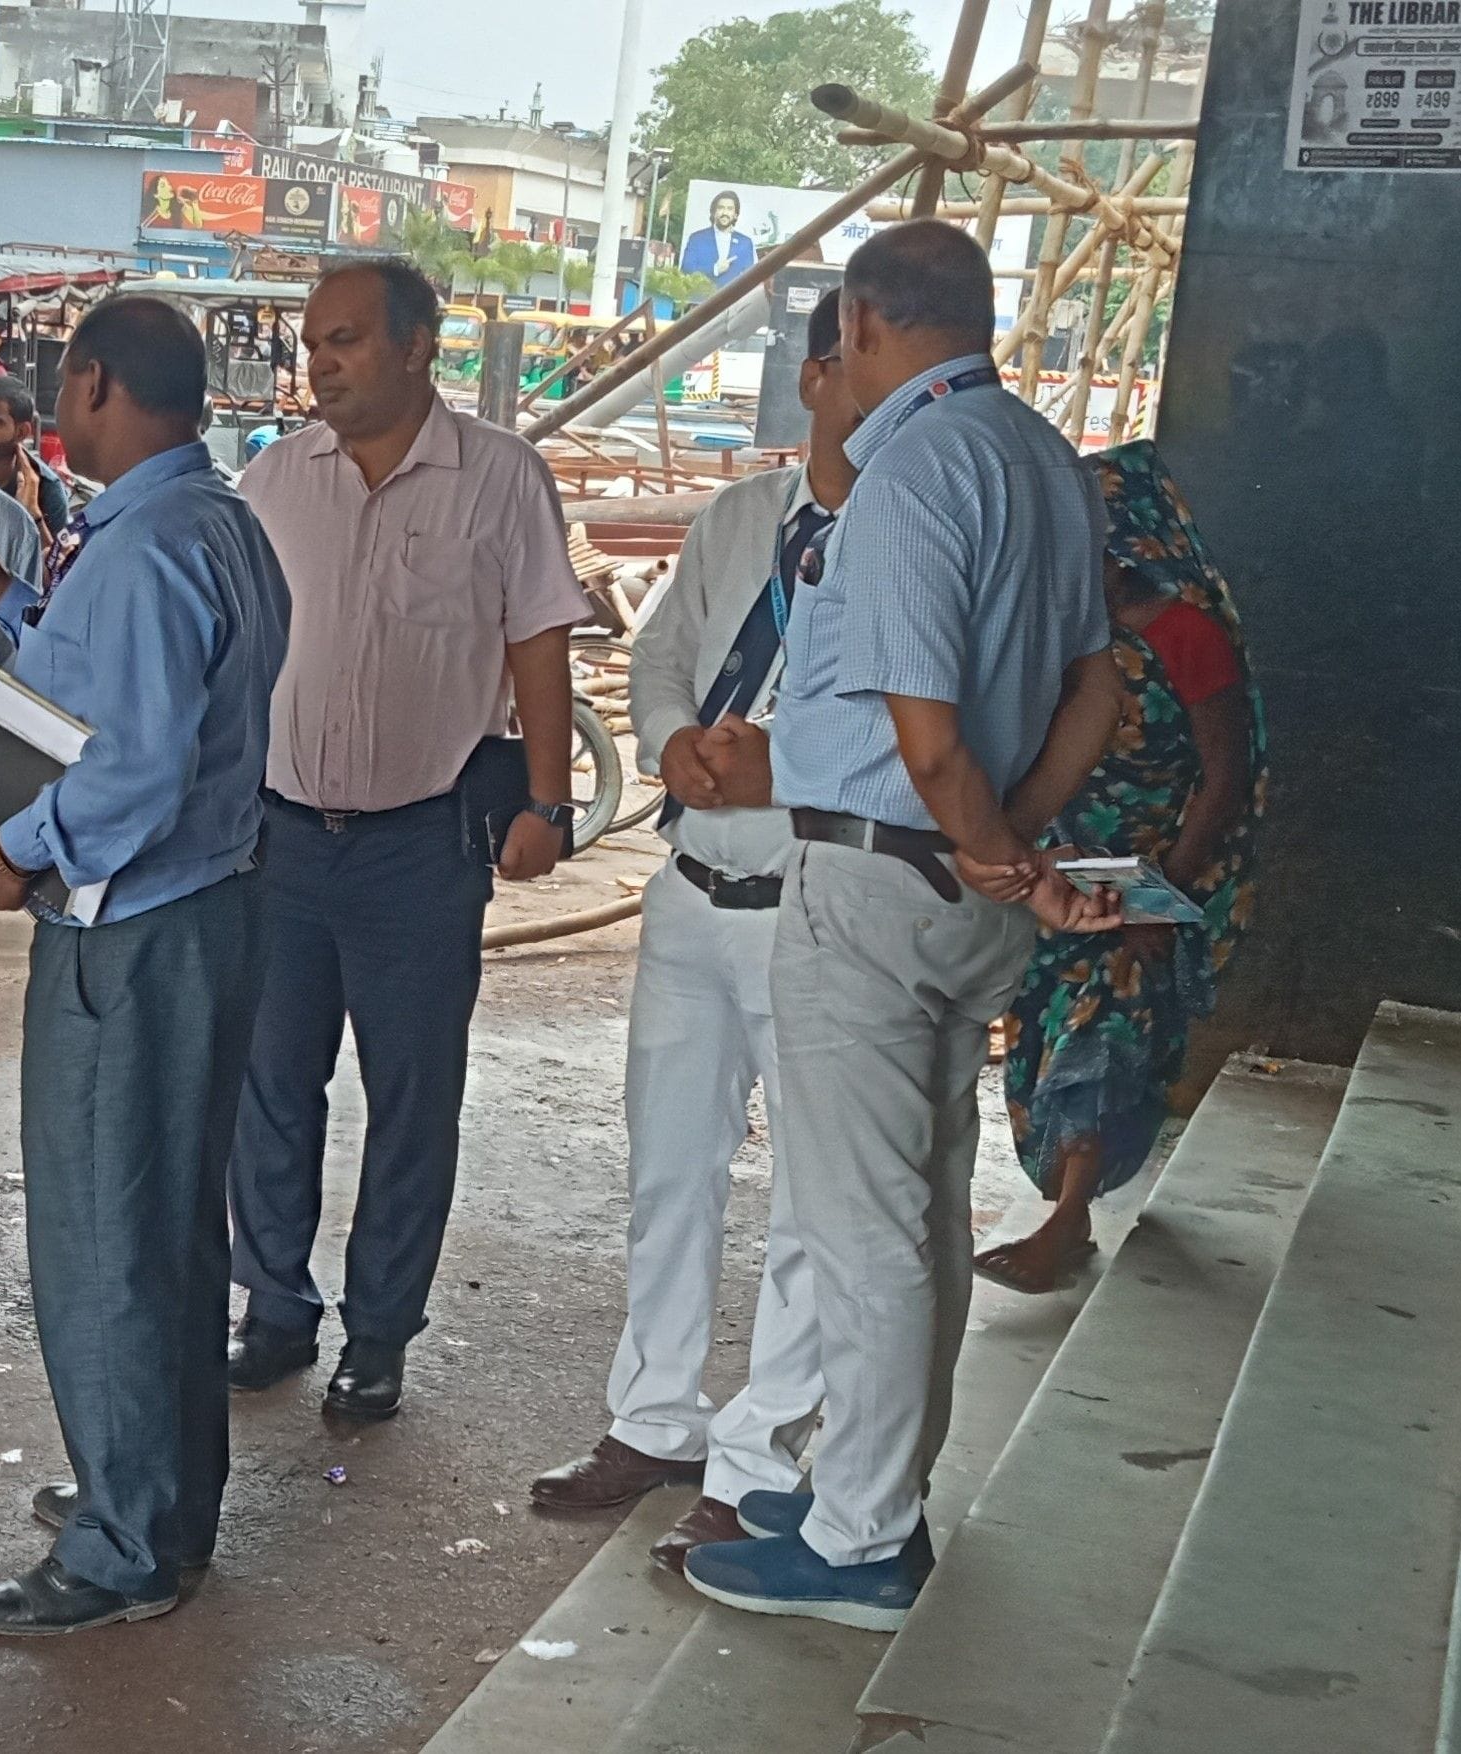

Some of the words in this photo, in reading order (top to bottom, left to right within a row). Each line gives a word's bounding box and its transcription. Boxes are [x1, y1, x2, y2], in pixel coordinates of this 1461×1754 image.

[1348, 2, 1384, 25] THE
[261, 154, 291, 178] RAIL
[295, 160, 346, 185] COACH
[348, 170, 425, 204] RESTAURANT
